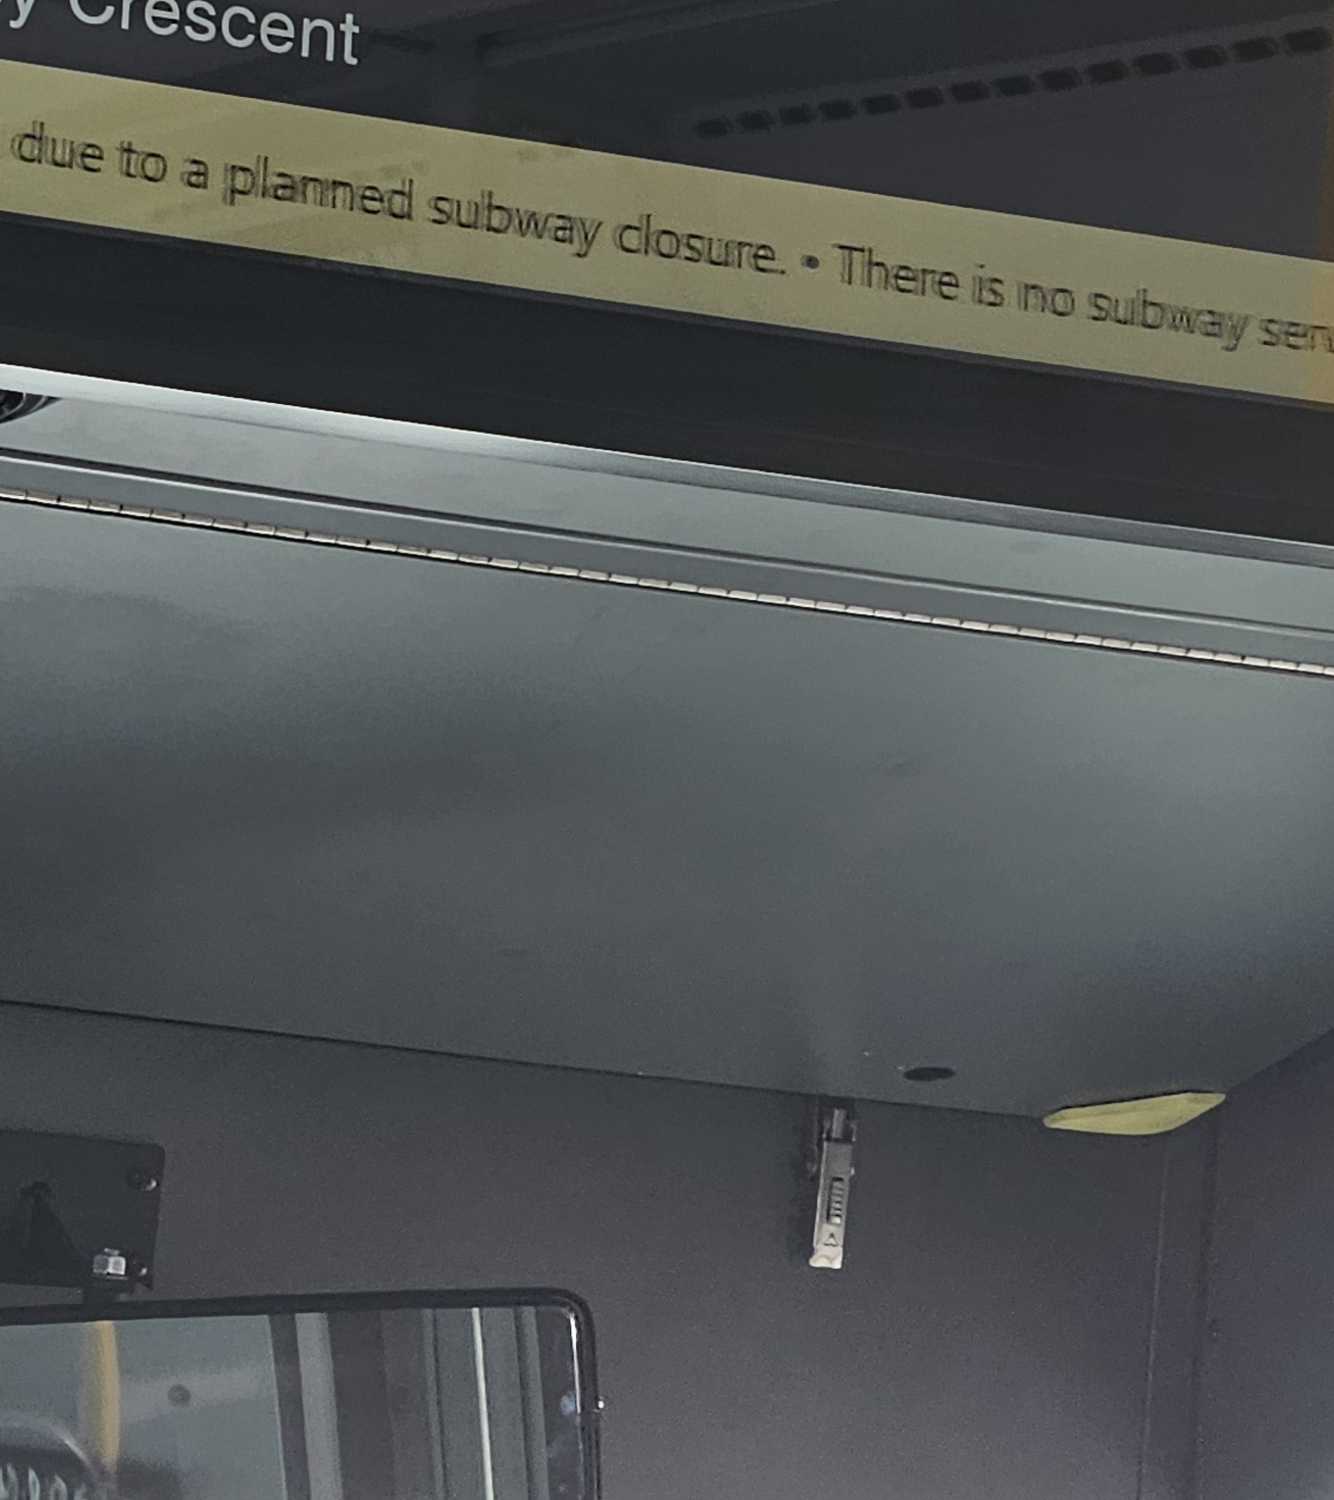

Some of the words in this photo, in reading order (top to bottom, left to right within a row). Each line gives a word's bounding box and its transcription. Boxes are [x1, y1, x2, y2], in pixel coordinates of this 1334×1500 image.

[10, 120, 105, 173] due
[116, 138, 168, 184] to
[181, 158, 209, 190] a
[222, 155, 414, 221] planned
[428, 190, 603, 258] subway
[613, 213, 787, 275] closure.
[833, 243, 960, 301] There
[972, 263, 1005, 308] is
[1016, 279, 1076, 317] no
[1087, 288, 1250, 352] subway
